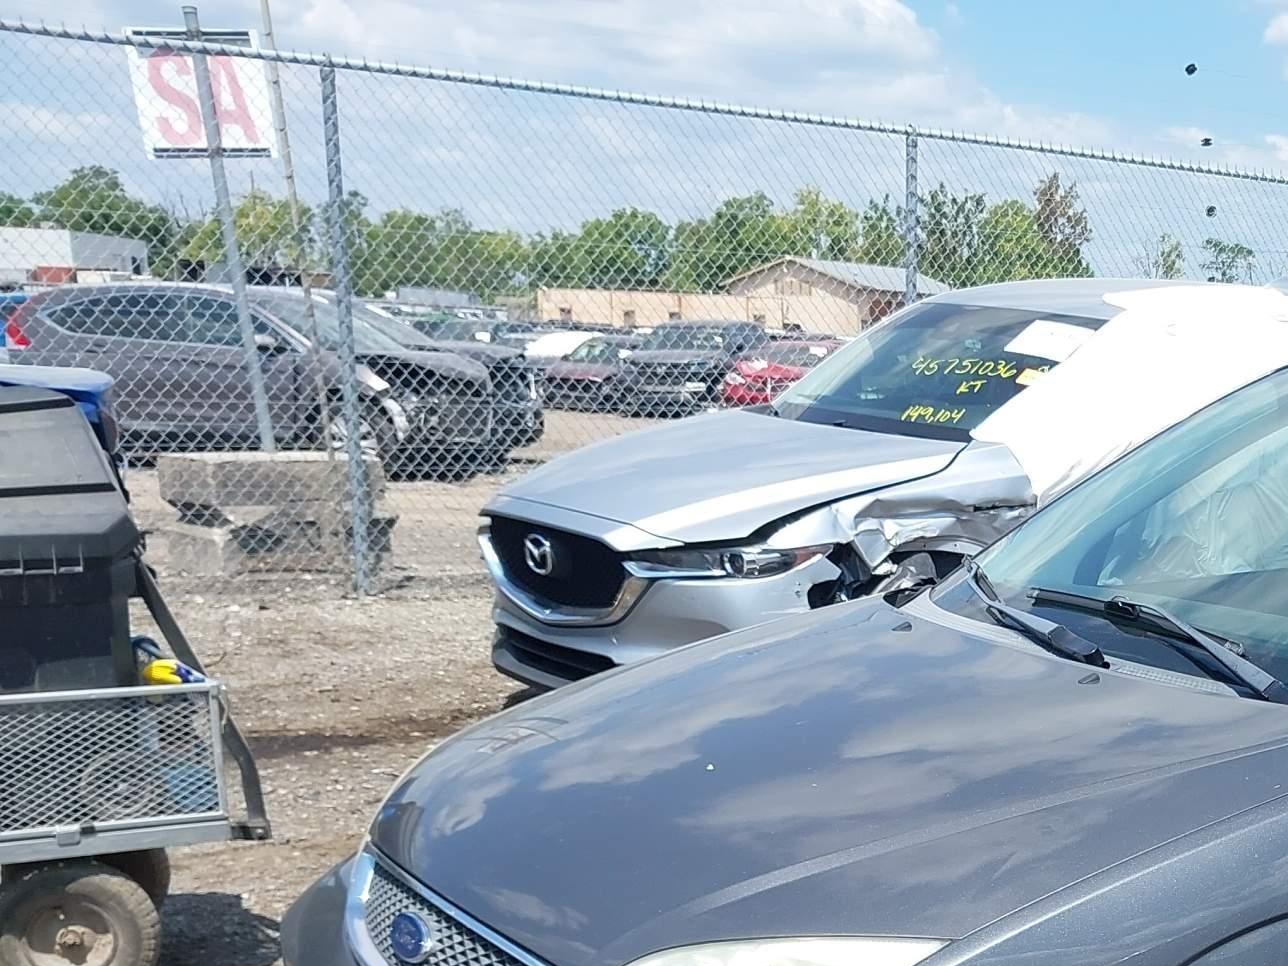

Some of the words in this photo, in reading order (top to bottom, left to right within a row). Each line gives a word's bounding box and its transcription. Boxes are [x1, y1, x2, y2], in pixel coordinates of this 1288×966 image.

[147, 46, 260, 146] SA
[912, 356, 1017, 378] 45751036
[956, 380, 987, 394] KT
[901, 405, 966, 424] 149,104
